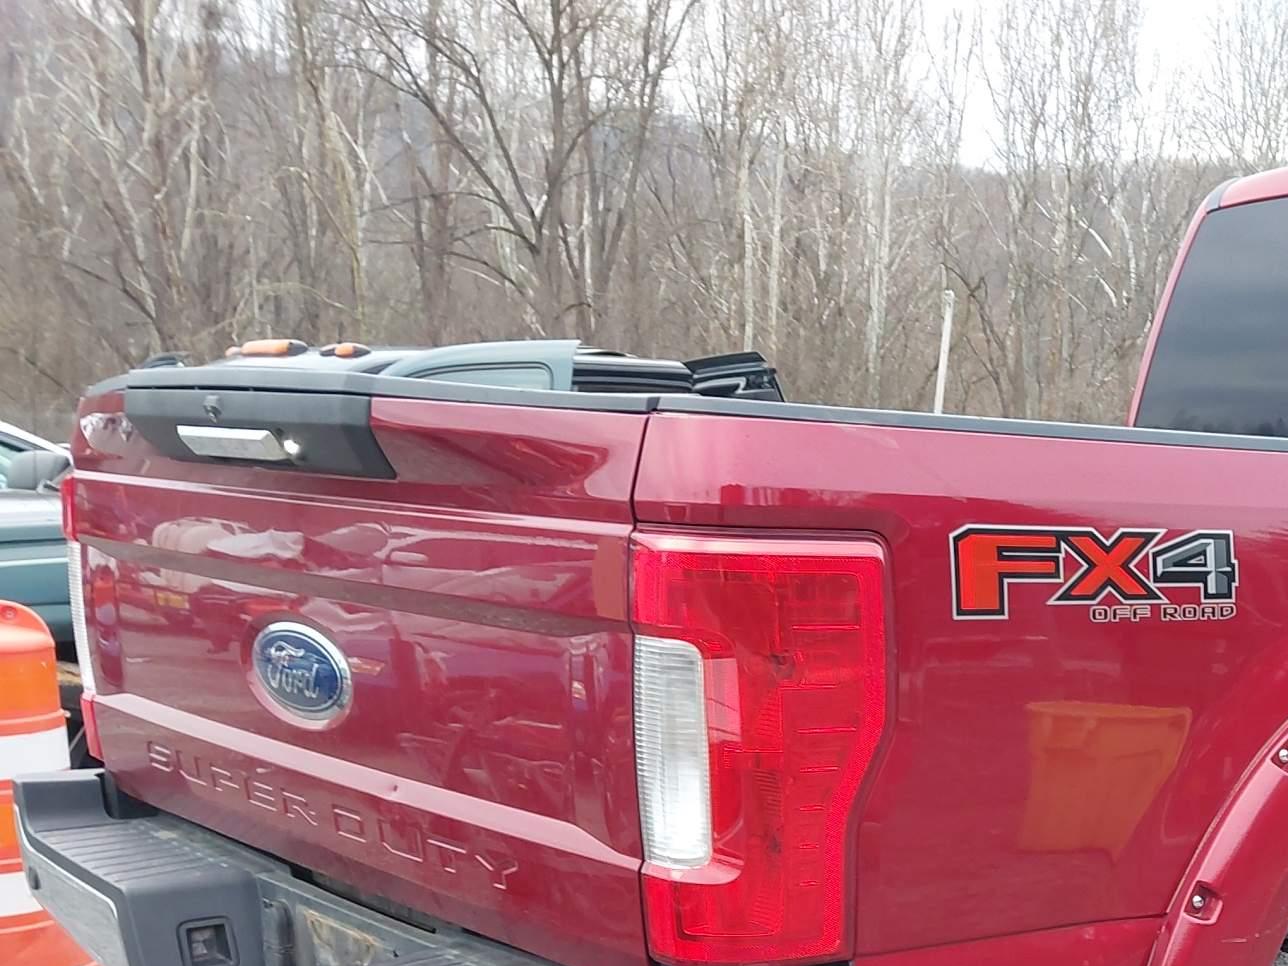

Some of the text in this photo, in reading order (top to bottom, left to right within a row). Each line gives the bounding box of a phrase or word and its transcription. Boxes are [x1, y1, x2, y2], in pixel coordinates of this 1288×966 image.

[949, 523, 1239, 620] FX4
[1090, 603, 1238, 623] OFF ROAD
[264, 640, 320, 700] Ford
[145, 740, 519, 890] SUPER DUTY
